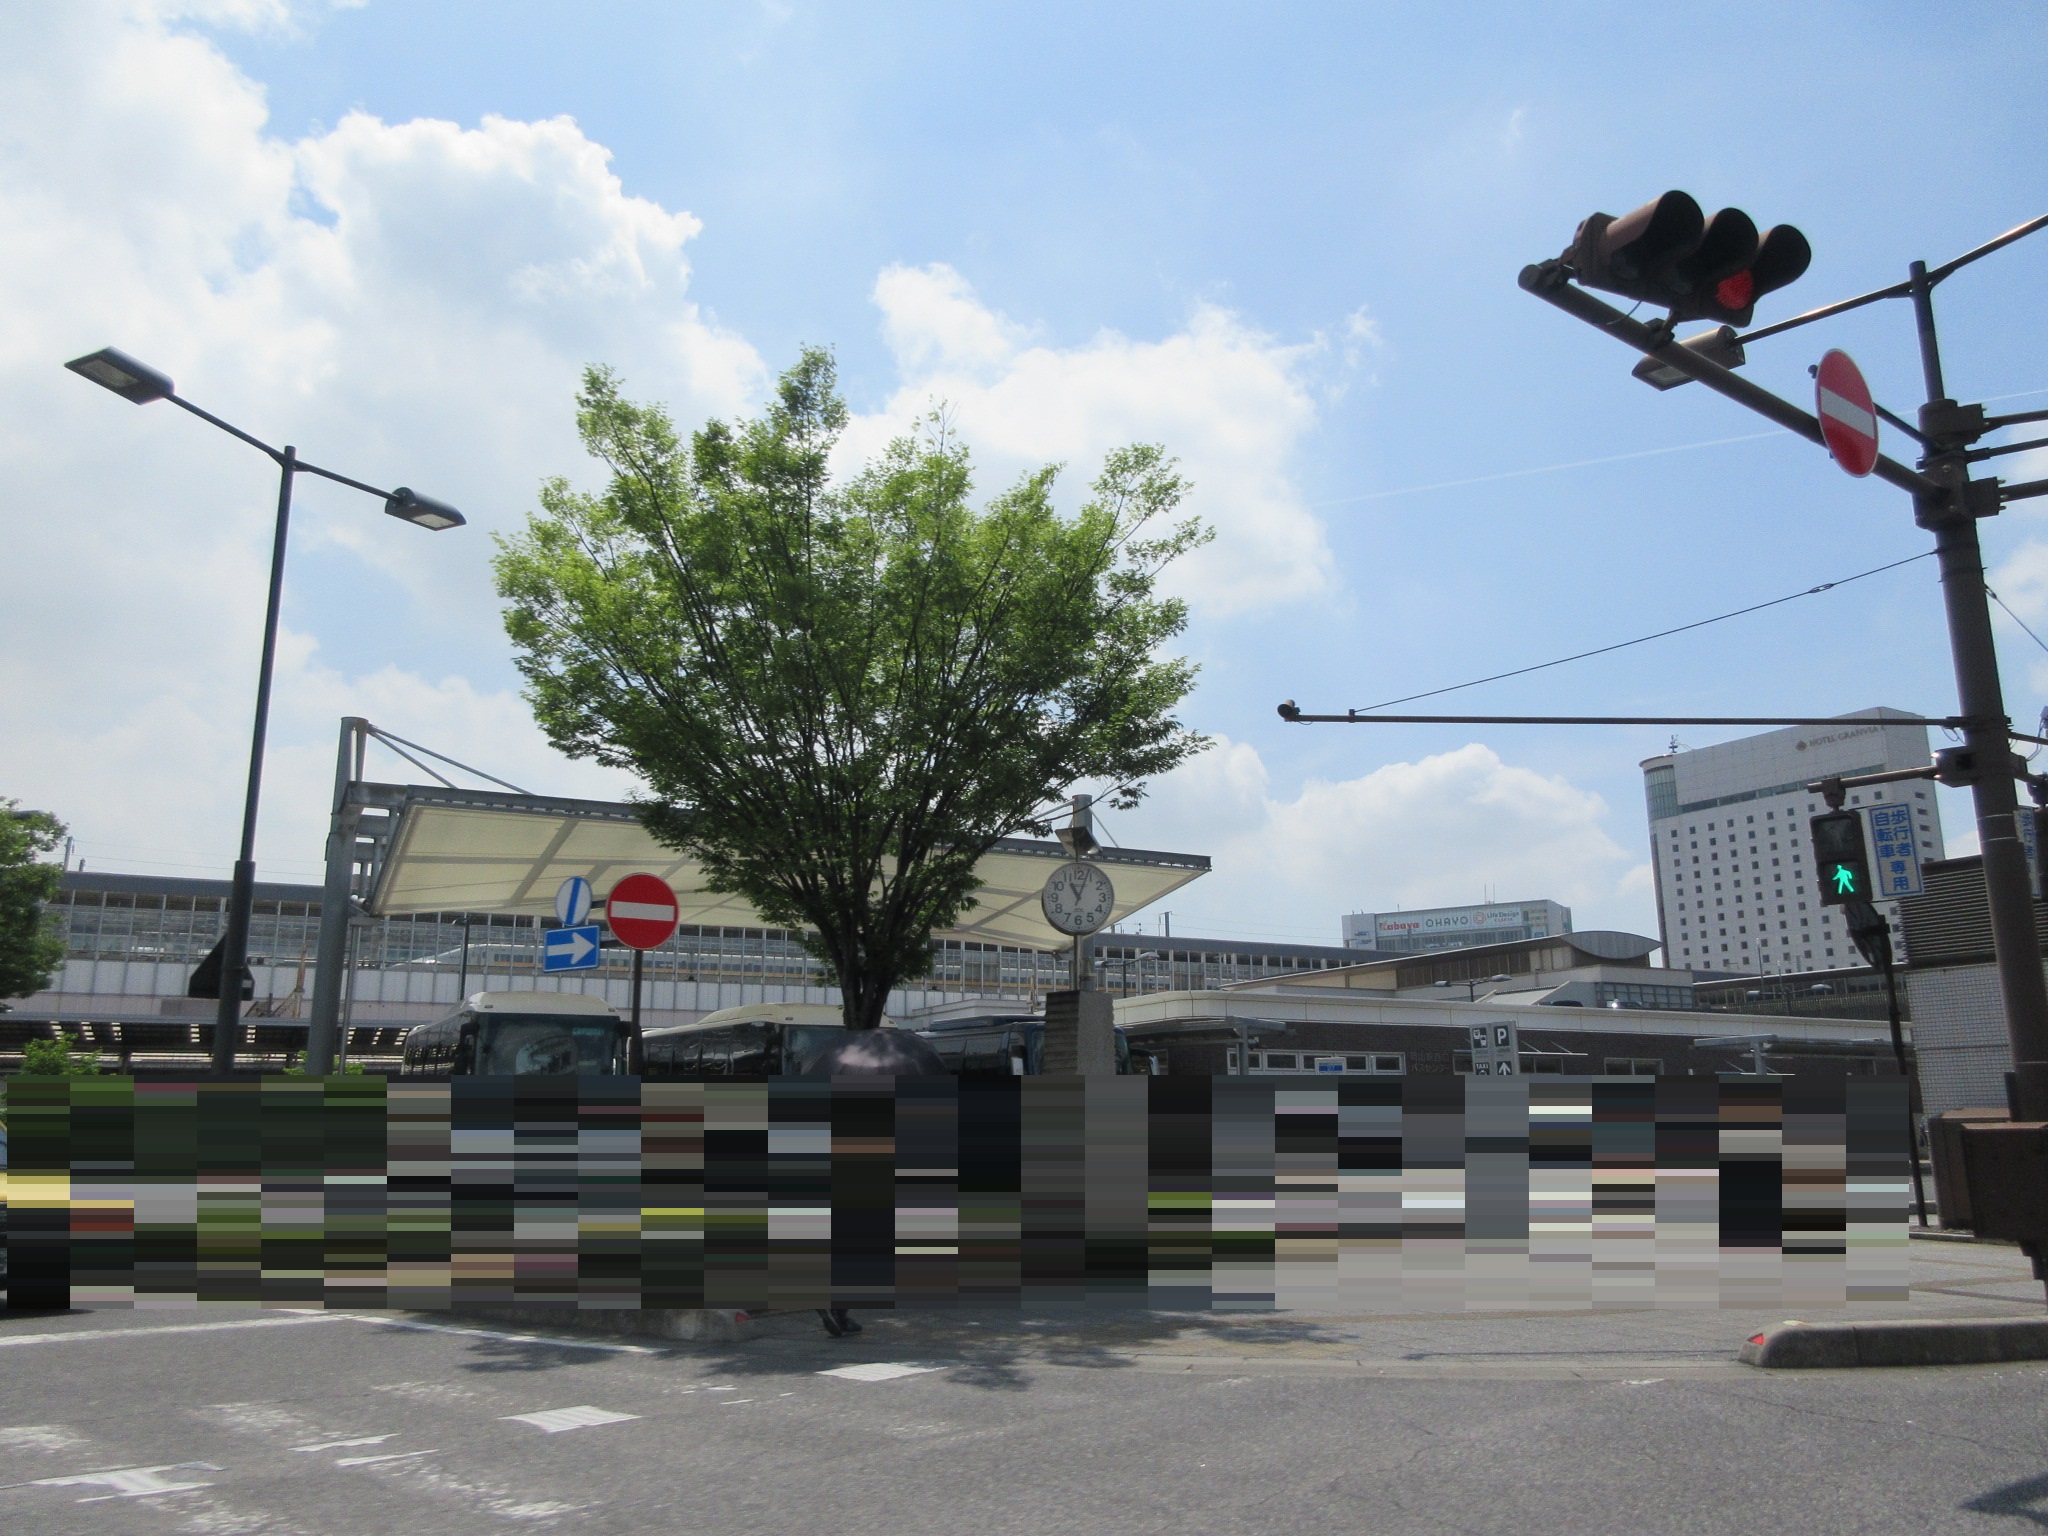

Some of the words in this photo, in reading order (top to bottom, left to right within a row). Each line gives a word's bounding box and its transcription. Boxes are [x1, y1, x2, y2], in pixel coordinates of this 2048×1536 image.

[1874, 811, 1896, 858] 自転車
[1891, 809, 1912, 857] 歩行者
[1074, 870, 1085, 880] 12
[1889, 860, 1909, 891] 専用
[1054, 881, 1064, 891] 10
[1096, 881, 1103, 890] 2
[1051, 893, 1058, 903] 9
[1099, 893, 1106, 902] 3
[1055, 903, 1062, 914] 8
[1095, 904, 1103, 914] 4
[1064, 913, 1071, 922] 7
[1074, 915, 1082, 925] 6
[1086, 912, 1094, 922] 5
[1425, 916, 1469, 928] OHAYO
[1497, 1027, 1507, 1044] P
